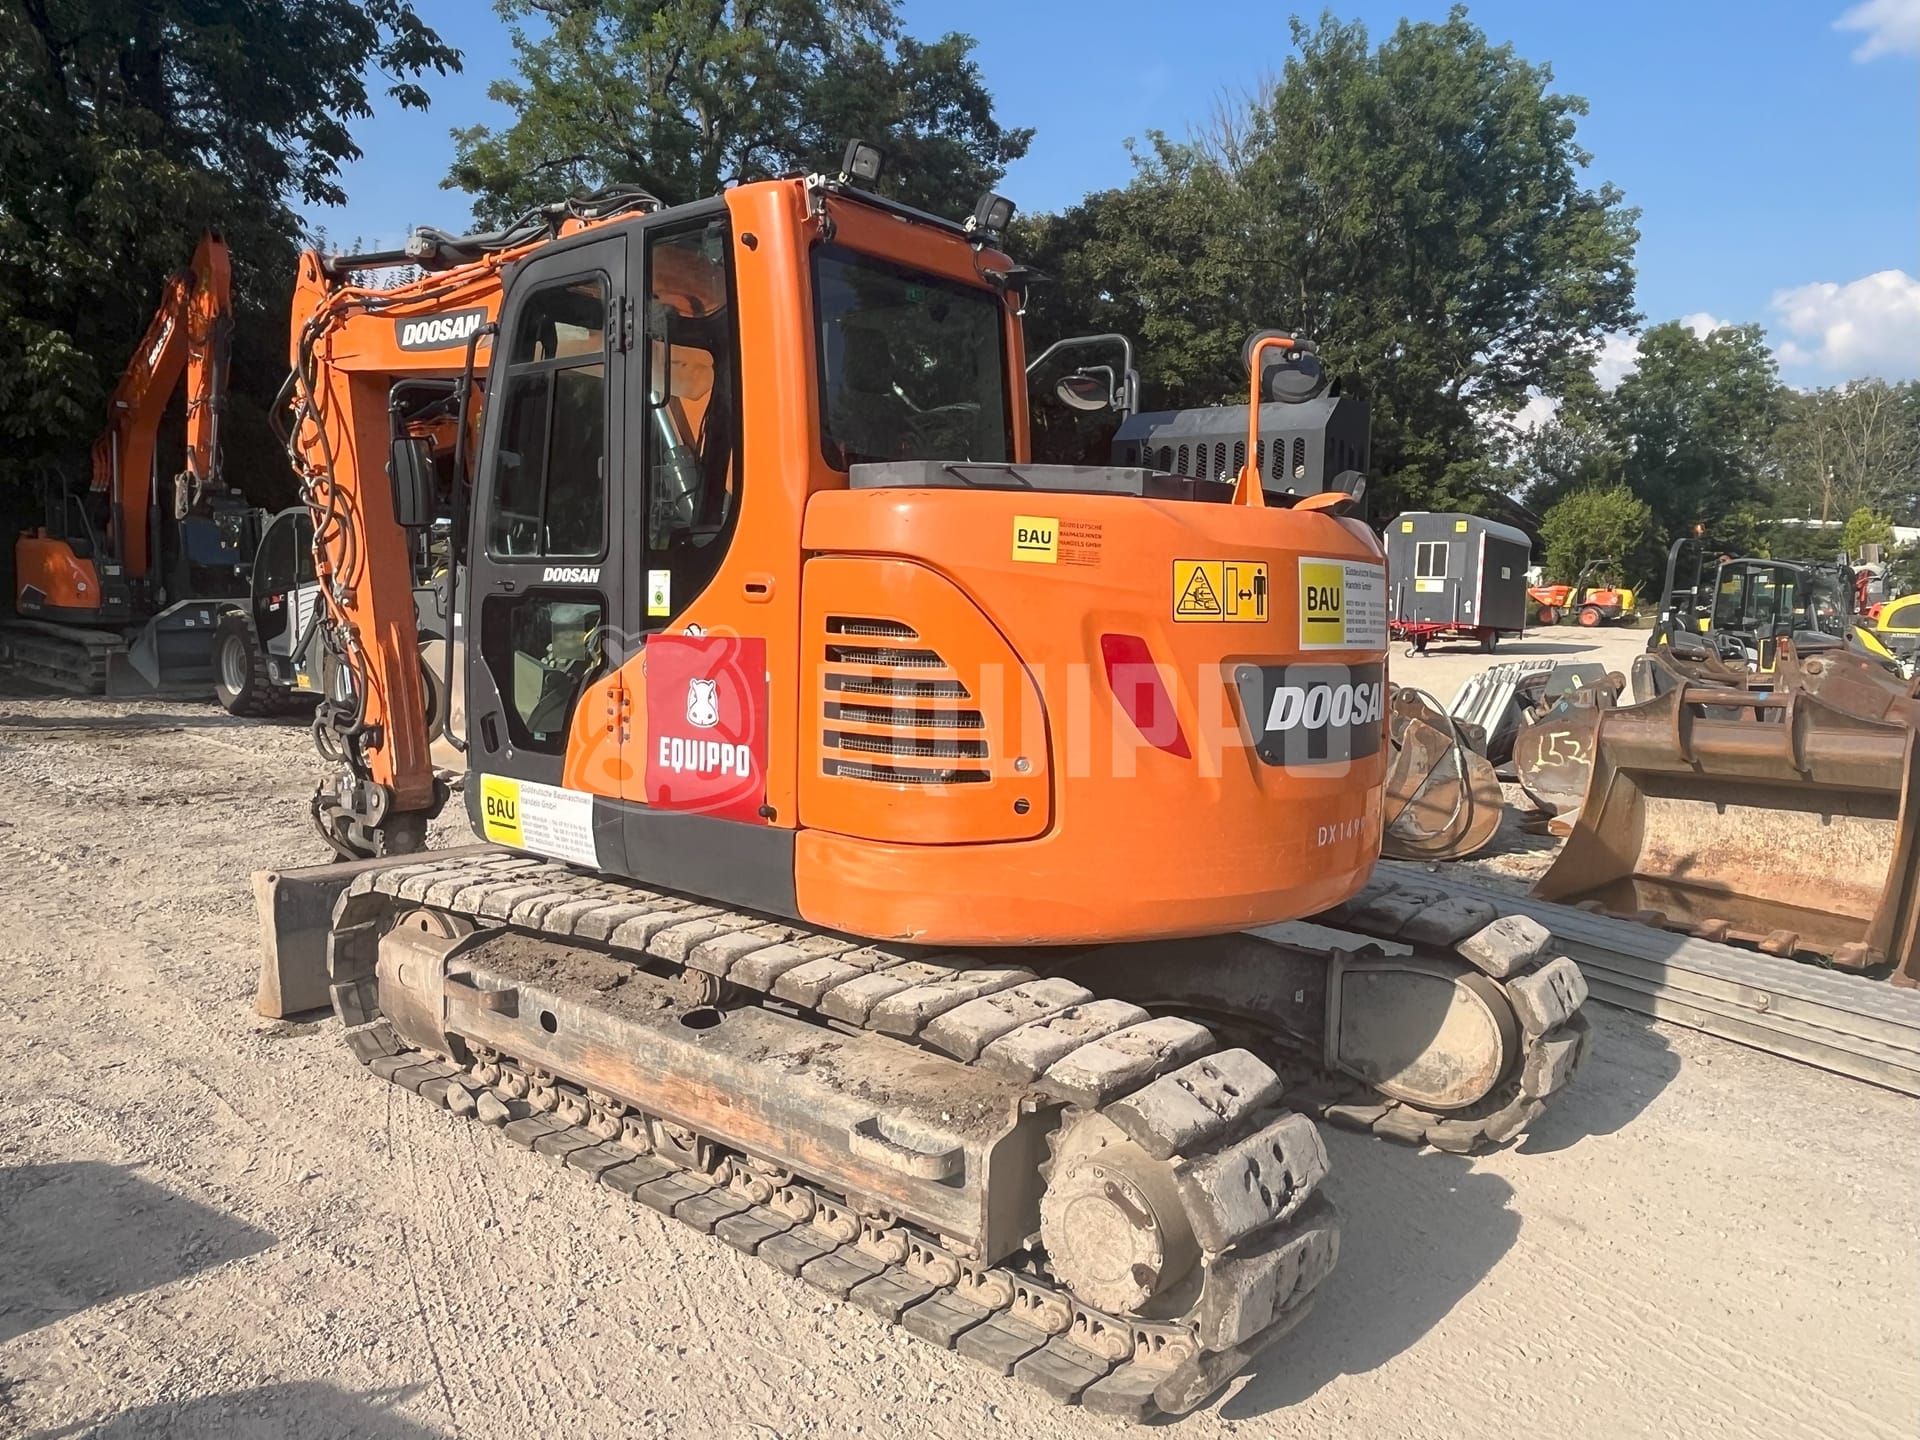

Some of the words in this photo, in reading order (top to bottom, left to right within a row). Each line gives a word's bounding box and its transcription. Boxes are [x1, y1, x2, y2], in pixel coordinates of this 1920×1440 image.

[402, 314, 480, 346] DOOSAN
[1017, 528, 1052, 544] BAU
[543, 567, 601, 583] DOOSAN
[1307, 586, 1340, 611] BAU
[659, 736, 751, 778] EQUIPPO
[487, 796, 515, 820] BAU
